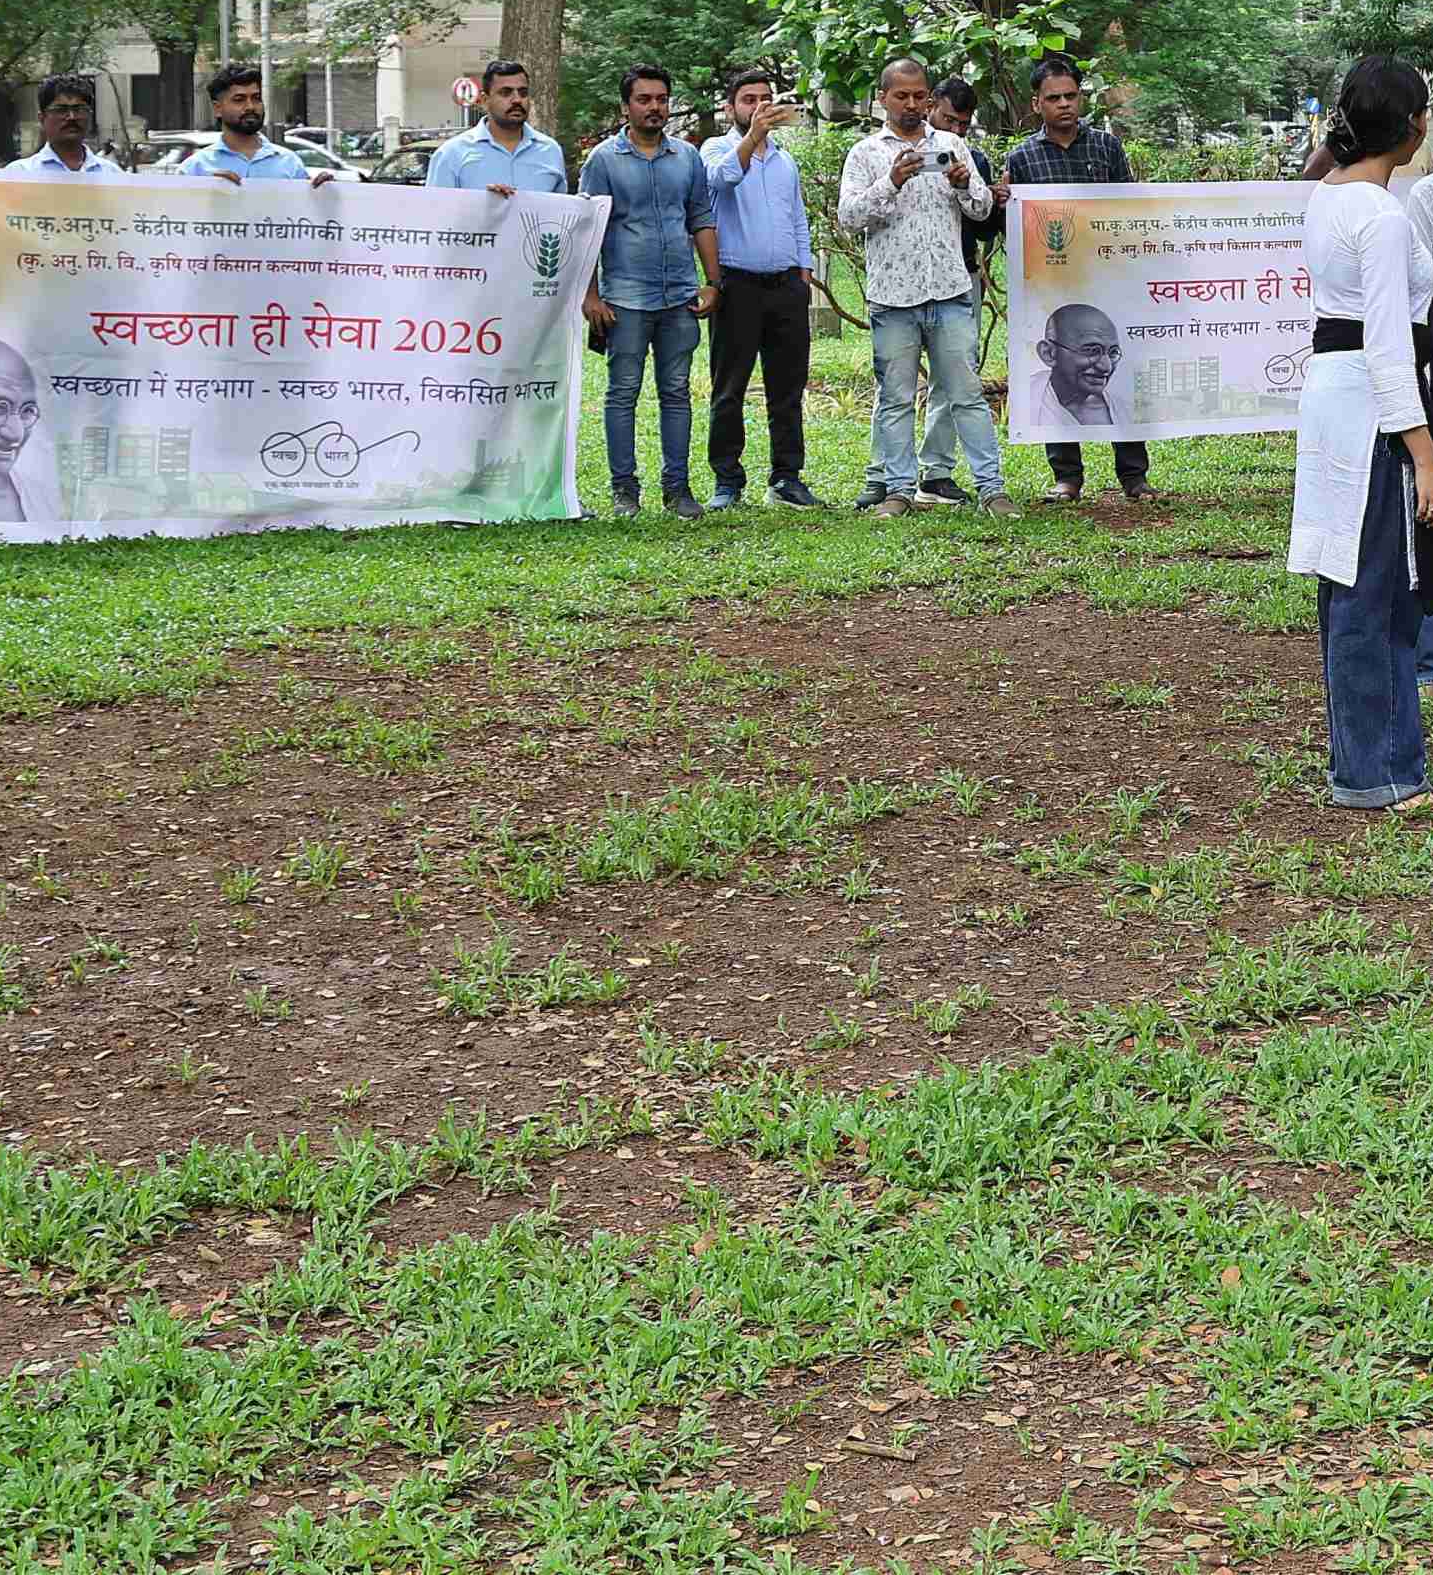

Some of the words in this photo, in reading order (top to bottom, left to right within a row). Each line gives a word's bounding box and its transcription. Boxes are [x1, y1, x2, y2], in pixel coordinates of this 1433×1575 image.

[133, 212, 187, 237] केंद्रीय
[193, 222, 249, 239] कपास
[254, 216, 344, 242] प्रौद्योगिकी
[351, 225, 432, 252] अनुसंधान
[437, 228, 497, 248] संस्थान
[1212, 217, 1248, 229] कपास
[1227, 238, 1261, 252] किसान
[51, 253, 82, 275] अनु.
[149, 252, 182, 277] कृषि
[187, 255, 208, 274] एवं
[213, 254, 262, 272] किसान
[266, 259, 322, 275] कल्याण
[328, 260, 387, 278] मंत्रालय,
[392, 265, 429, 279] भारत
[434, 266, 487, 284] सरकार)
[1147, 279, 1247, 304] स्वच्छता
[1255, 269, 1283, 304] ही
[89, 311, 239, 348] स्वच्छता
[251, 302, 291, 355] ही
[302, 301, 381, 350] सेवा
[392, 317, 503, 355] 2026
[1126, 324, 1183, 340] स्वच्छता
[1189, 318, 1202, 337] में
[1205, 321, 1260, 339] सहभाग
[51, 375, 141, 397] स्वच्छता
[148, 371, 167, 398] में
[174, 379, 254, 403] सहभाग
[279, 380, 340, 400] स्वच्छ
[348, 380, 410, 405] भारत,
[420, 376, 508, 405] विकसित
[514, 380, 558, 400] भारत
